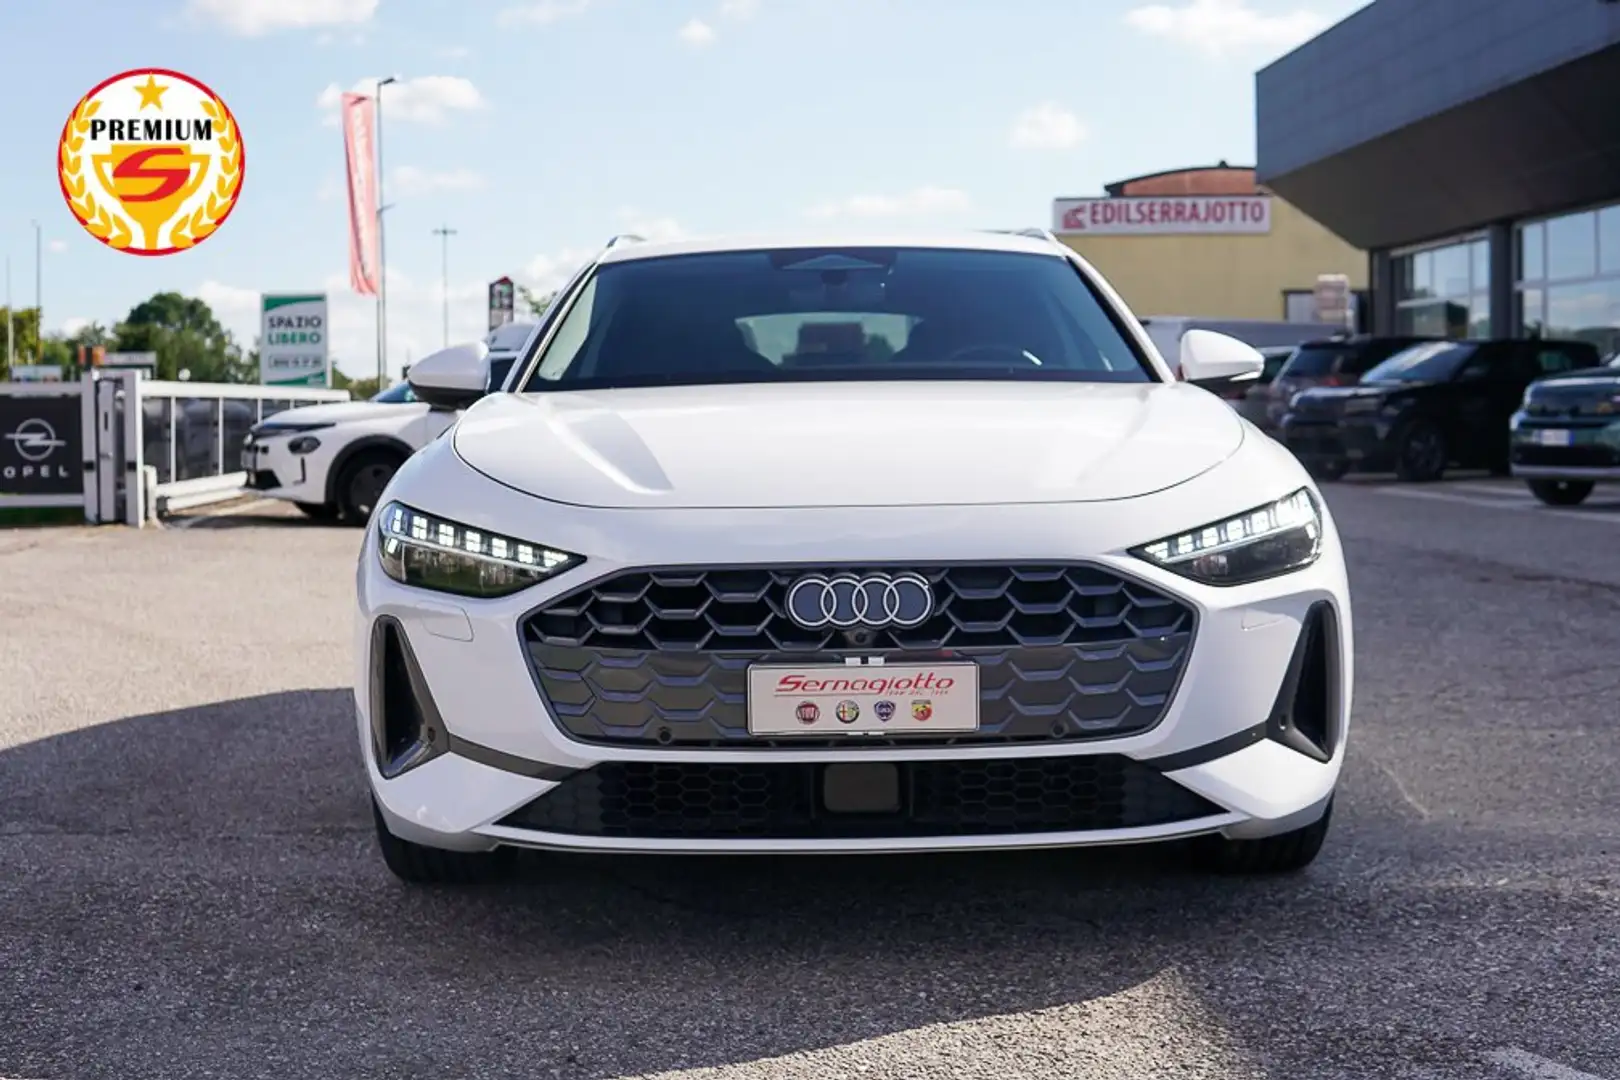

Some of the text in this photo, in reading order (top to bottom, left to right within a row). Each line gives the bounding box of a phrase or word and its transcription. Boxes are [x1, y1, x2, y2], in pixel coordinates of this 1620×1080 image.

[1090, 202, 1264, 224] EDILSERRAJOTTO
[267, 315, 322, 329] SPAZIO
[267, 331, 321, 345] LIBERO
[3, 465, 69, 479] OPEL
[776, 672, 954, 694] Sernagiotto
